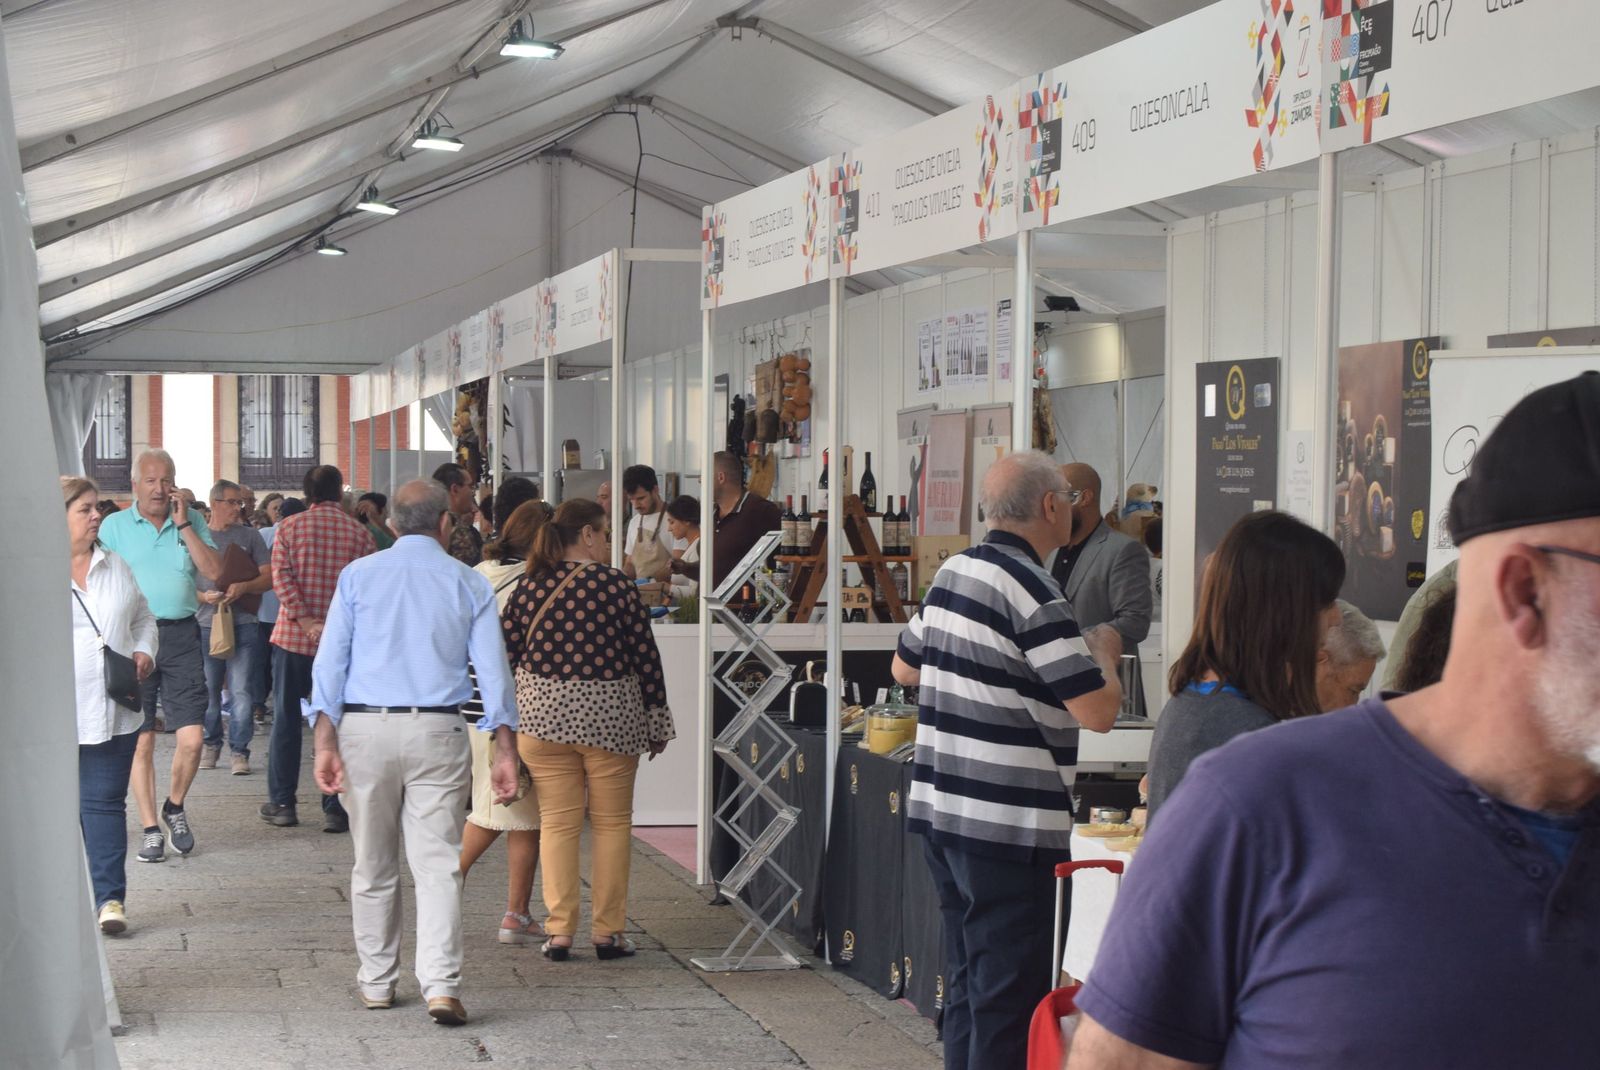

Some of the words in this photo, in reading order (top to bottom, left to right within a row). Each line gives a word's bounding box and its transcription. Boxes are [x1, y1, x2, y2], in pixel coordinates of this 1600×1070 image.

[1412, 0, 1453, 44] 407
[1130, 82, 1210, 132] QUESONCALA
[1072, 118, 1097, 153] 409
[896, 159, 925, 190] QUESOS
[925, 155, 936, 180] DE
